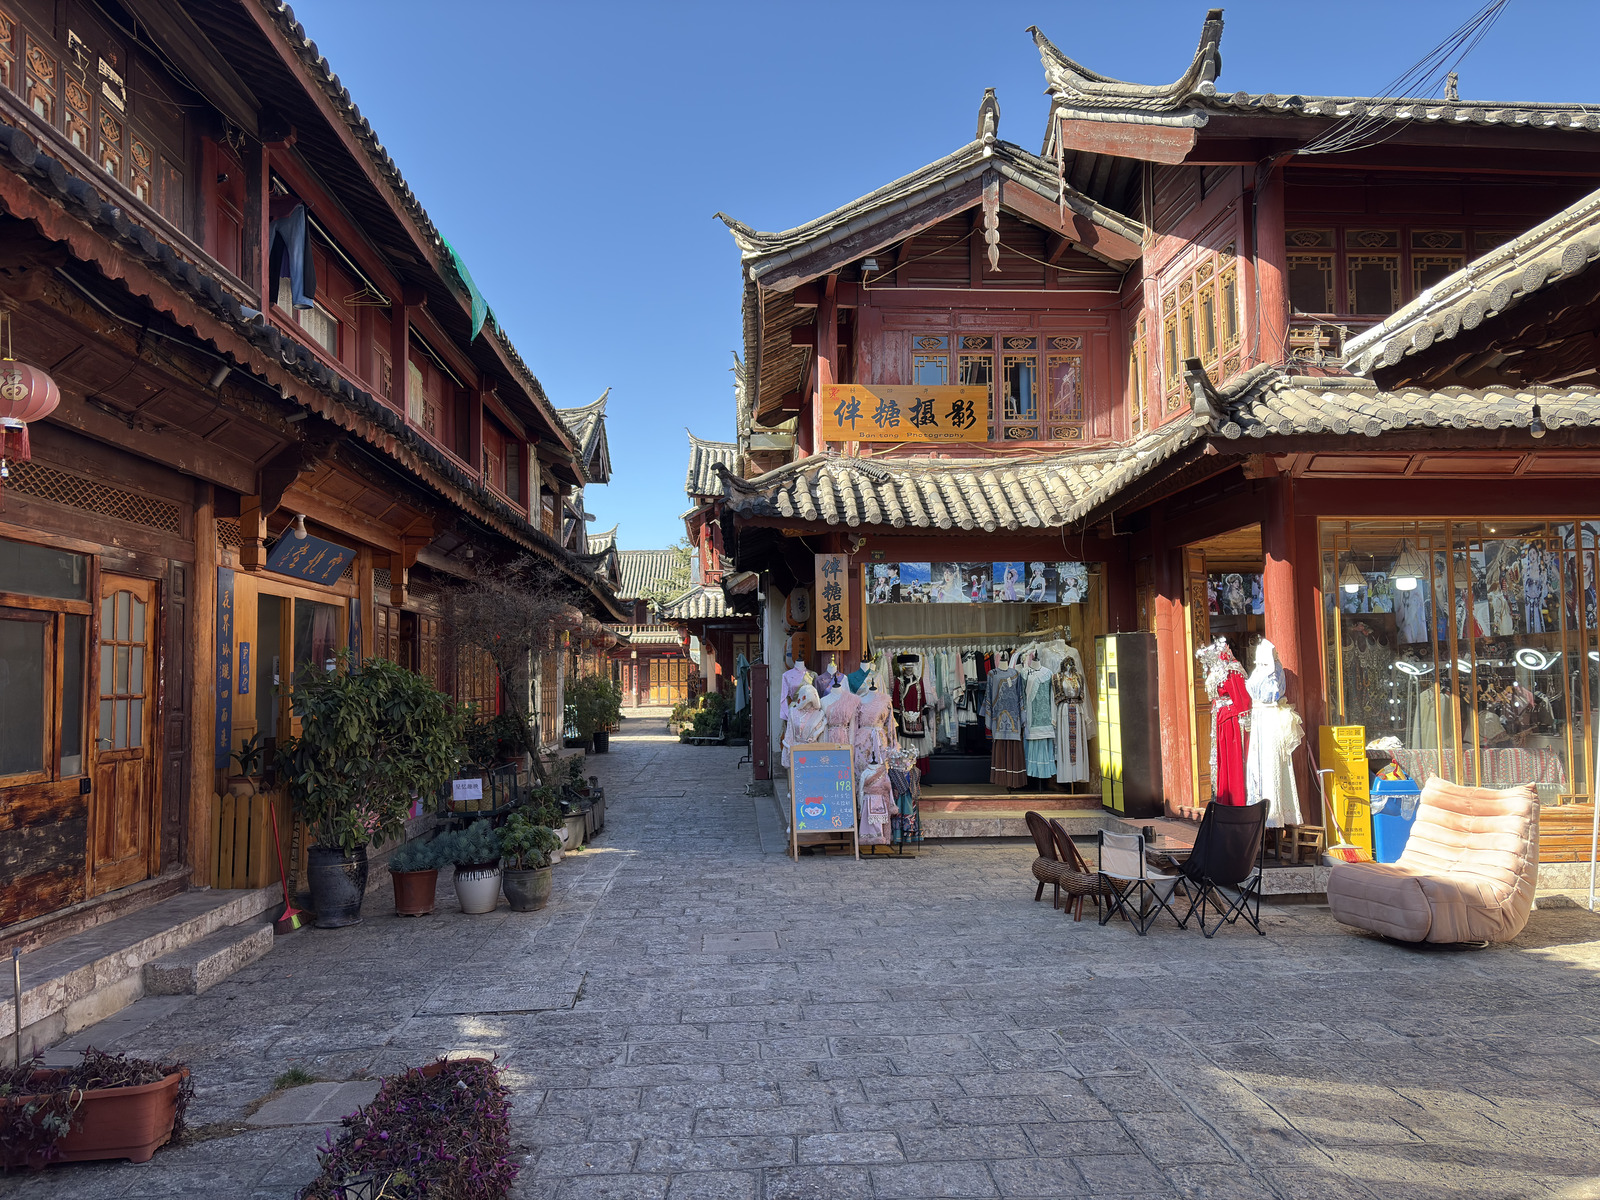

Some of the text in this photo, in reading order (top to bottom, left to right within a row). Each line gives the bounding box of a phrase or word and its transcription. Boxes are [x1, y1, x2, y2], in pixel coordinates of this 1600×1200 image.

[0, 367, 29, 401] 福
[833, 395, 977, 431] 伴糖摄影
[821, 557, 843, 646] 伴糖摄影
[836, 781, 851, 791] 198
[838, 770, 849, 779] 88
